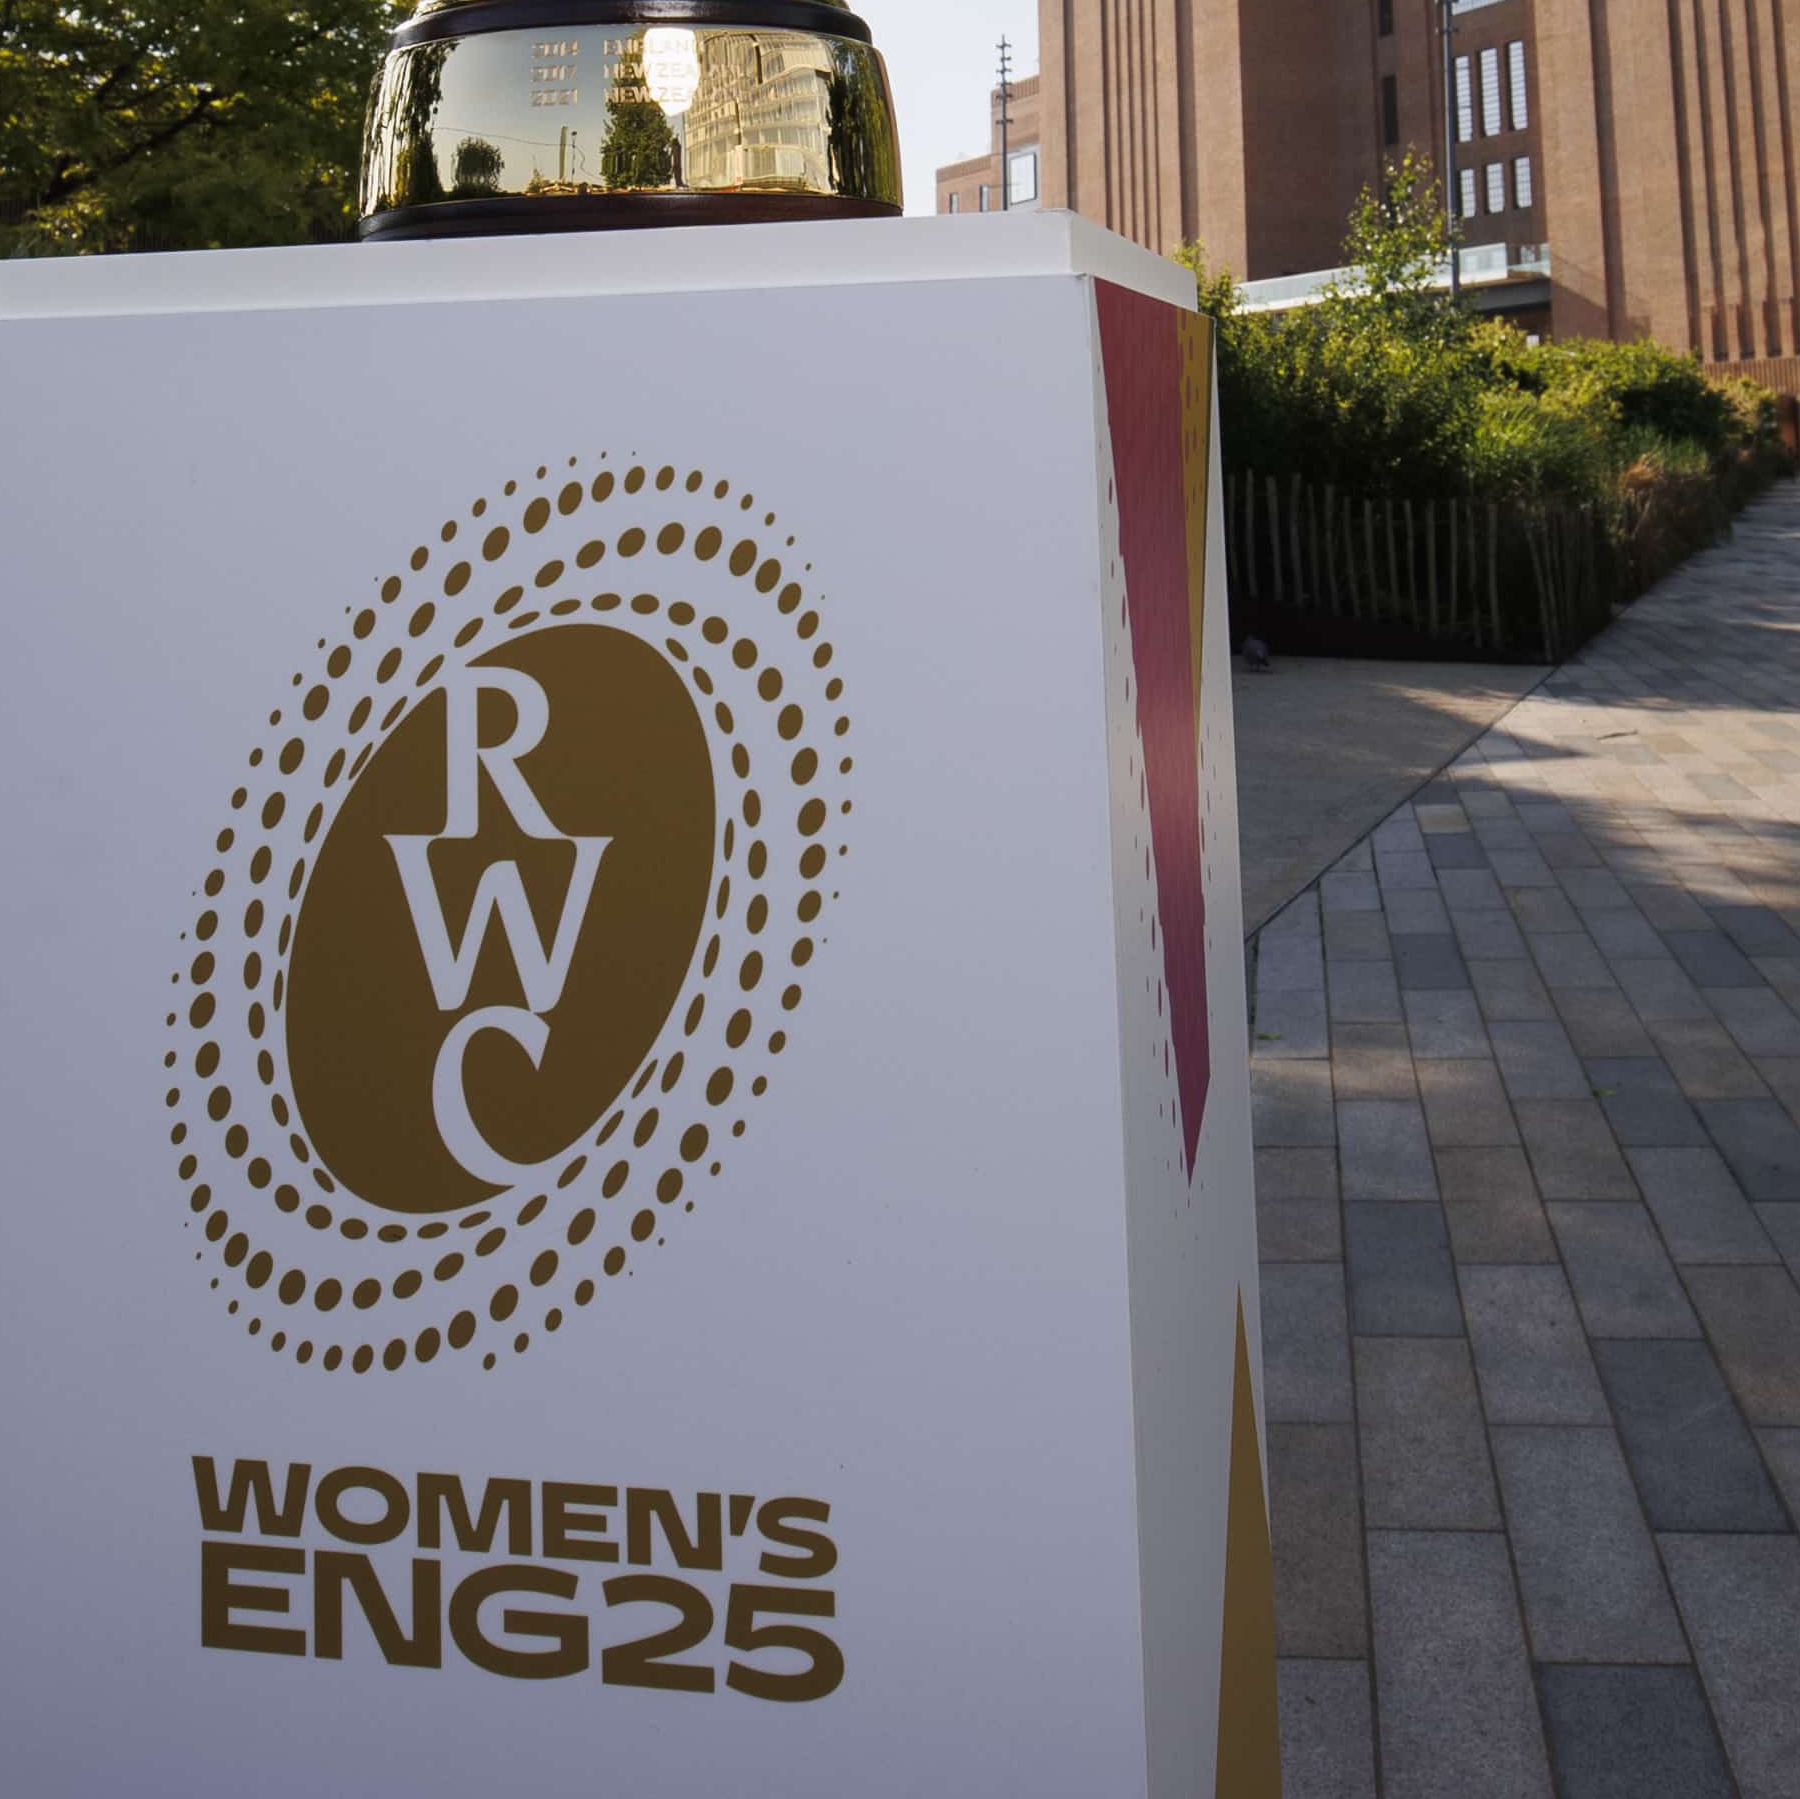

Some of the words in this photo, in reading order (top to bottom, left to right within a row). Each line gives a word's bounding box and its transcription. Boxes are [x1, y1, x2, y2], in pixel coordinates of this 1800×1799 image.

[603, 62, 651, 80] NEW
[656, 61, 750, 82] ZEAAND
[603, 86, 653, 104] NEW
[383, 665, 615, 1188] RWC
[191, 1454, 841, 1580] WOMEN'S
[200, 1539, 847, 1703] ENG25
